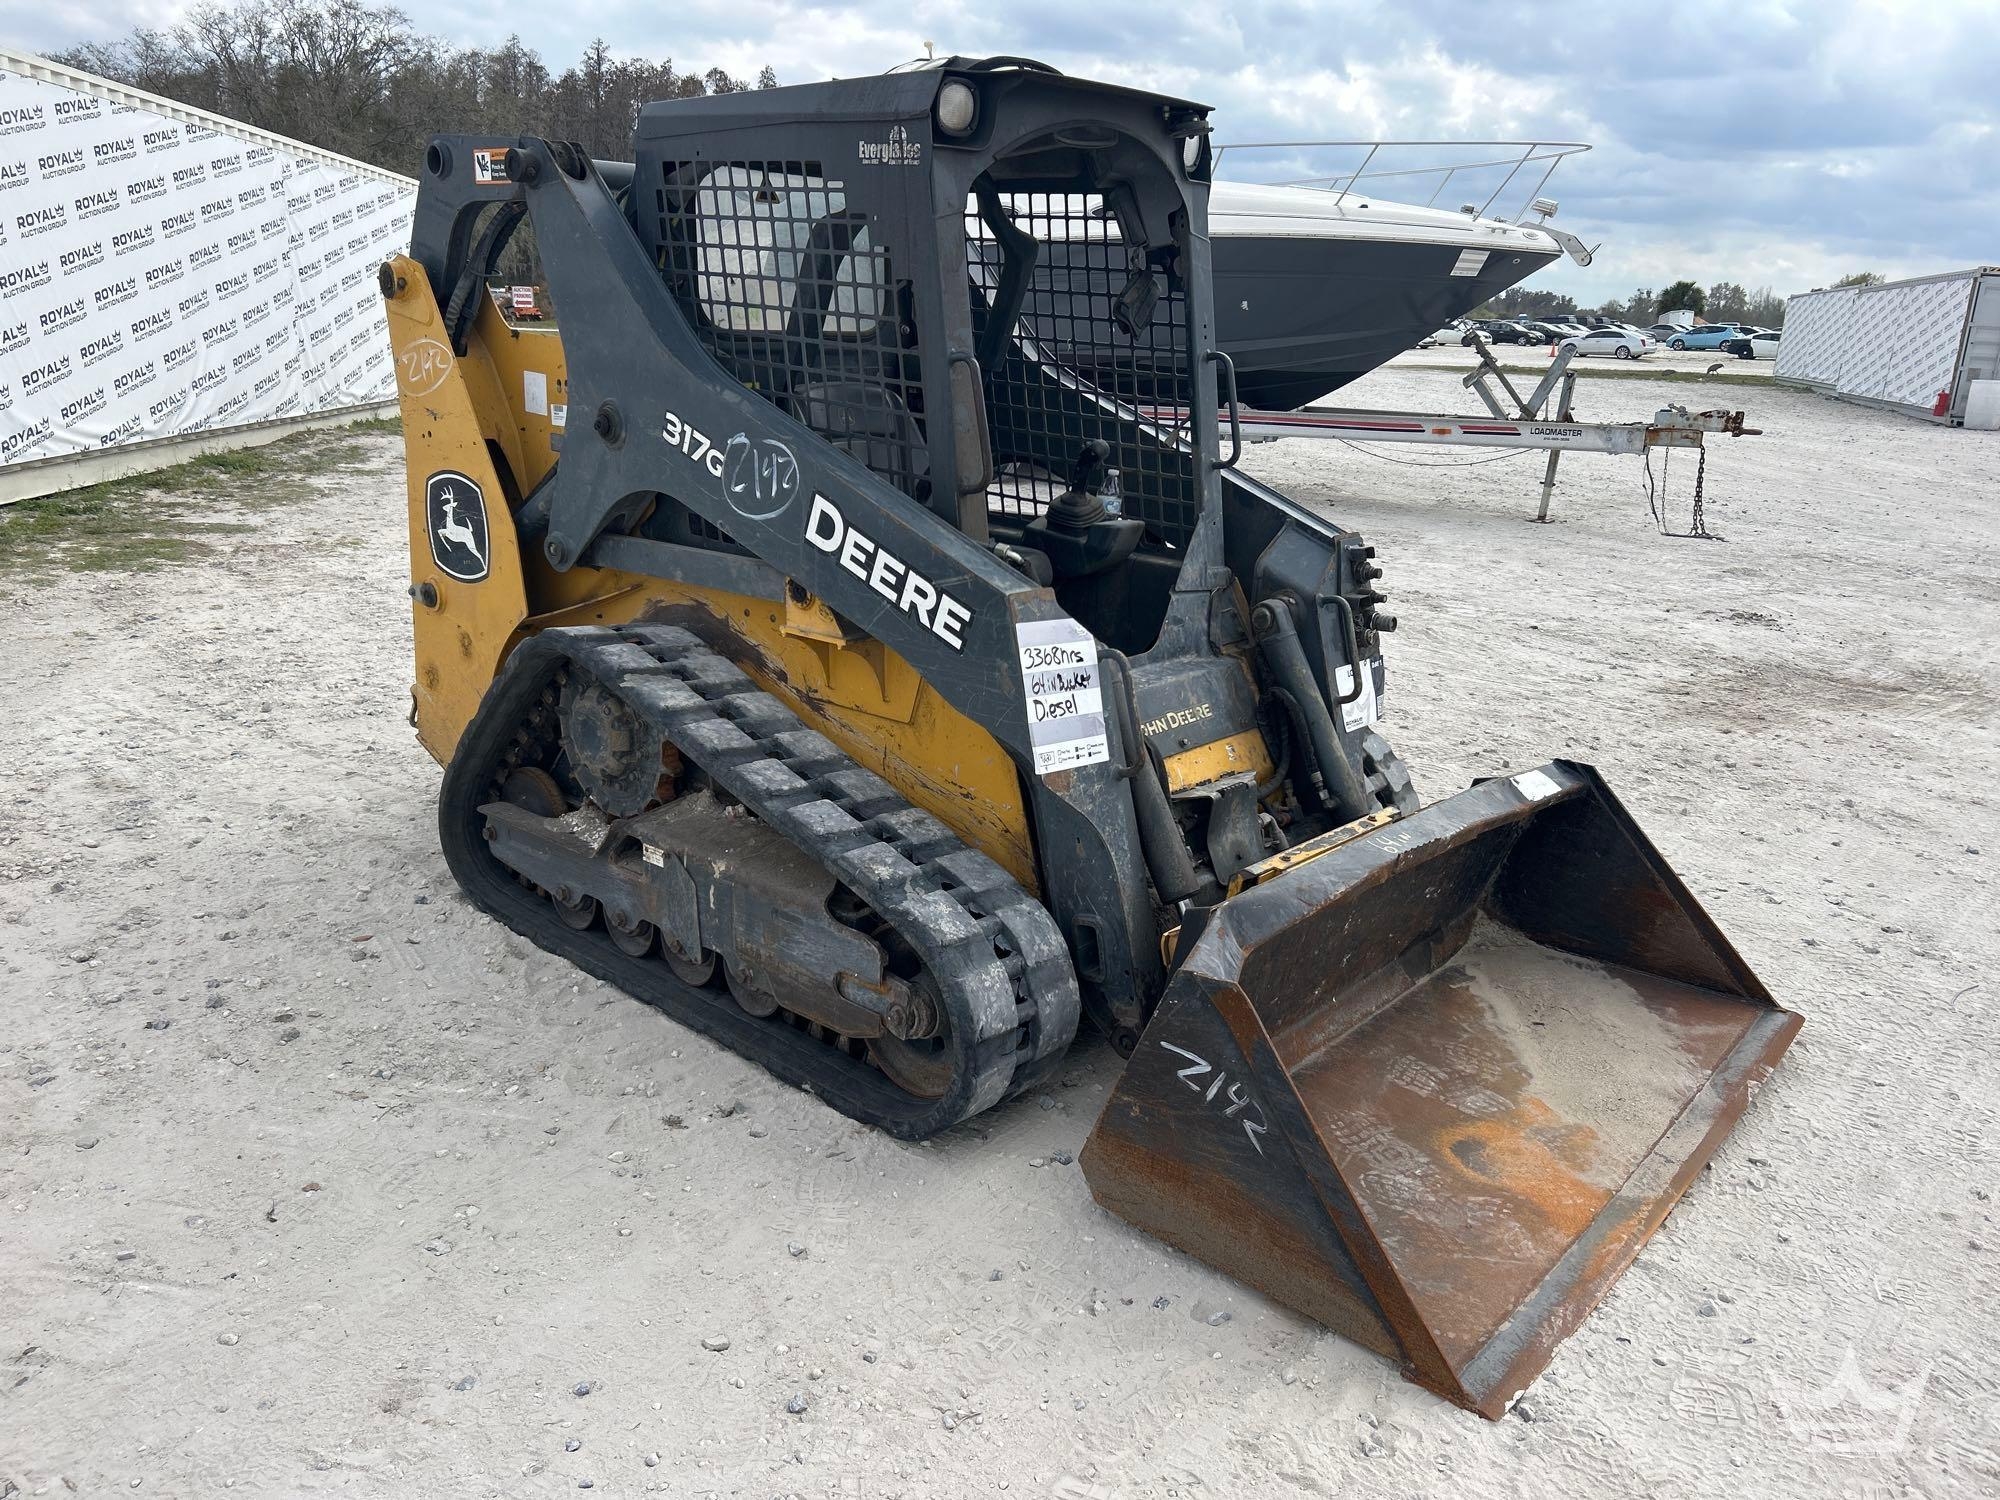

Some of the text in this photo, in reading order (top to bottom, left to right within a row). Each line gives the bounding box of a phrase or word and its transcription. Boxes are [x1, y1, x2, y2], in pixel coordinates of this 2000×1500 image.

[54, 99, 90, 115] ROYAL
[59, 111, 101, 125] AUCTION GROUP
[143, 130, 172, 145] ROYAL
[94, 140, 127, 157] ROYAL
[38, 152, 74, 170] ROYAL
[97, 152, 136, 166] AUCTION GROUP
[211, 156, 235, 170] ROYAL
[43, 164, 85, 180] AUCTION GROUP
[173, 167, 198, 182] ROYAL
[8, 178, 29, 188] GROUP
[128, 179, 158, 196] ROYAL
[270, 180, 284, 191] ROY
[75, 192, 109, 211] ROYAL
[131, 189, 167, 204] AUCTION GROUP
[79, 203, 120, 220] AUCTION GROUP
[201, 200, 226, 216] ROYAL
[16, 208, 56, 229] ROYAL
[162, 214, 189, 231] ROYAL
[21, 219, 67, 239] AUCTION GROUP
[112, 229, 145, 248] ROYAL
[116, 238, 155, 256] AUCTION GROUP
[228, 232, 250, 248] ROYAL
[60, 246, 94, 267] ROYAL
[189, 246, 212, 264] ROYAL
[64, 256, 104, 276] AUCTION GROUP
[146, 263, 175, 282] ROYAL
[0, 266, 40, 289] ROYAL
[4, 276, 52, 299] AUCTION GROUP
[215, 276, 242, 293] ROYAL
[94, 282, 127, 303] ROYAL
[98, 290, 138, 311] AUCTION GROUP
[179, 292, 204, 312] ROYAL
[40, 303, 76, 327] ROYAL
[44, 312, 87, 336] AUCTION GROUP
[131, 313, 162, 334] ROYAL
[135, 321, 172, 342] AUCTION GROUP
[202, 323, 228, 342] ROYAL
[9, 337, 30, 351] GROUP
[80, 336, 113, 359] ROYAL
[163, 344, 191, 364] ROYAL
[84, 344, 123, 368] AUCTION GROUP
[22, 362, 61, 388] ROYAL
[26, 370, 72, 397] AUCTION GROUP
[114, 367, 146, 390] ROYAL
[192, 370, 218, 391] ROYAL
[118, 374, 156, 399] AUCTION GROUP
[61, 394, 96, 420] ROYAL
[66, 401, 107, 429] AUCTION GROUP
[150, 394, 179, 417] ROYAL
[218, 396, 242, 416] ROYAL
[1, 424, 42, 453] ROYAL
[100, 421, 134, 446] ROYAL
[1530, 428, 1582, 436] LOADMASTER
[5, 431, 54, 463] AUCTION GROUP
[662, 411, 725, 478] 317G
[805, 493, 972, 650] DEERE
[1033, 694, 1078, 722] Diesel
[1140, 718, 1168, 736] OHN
